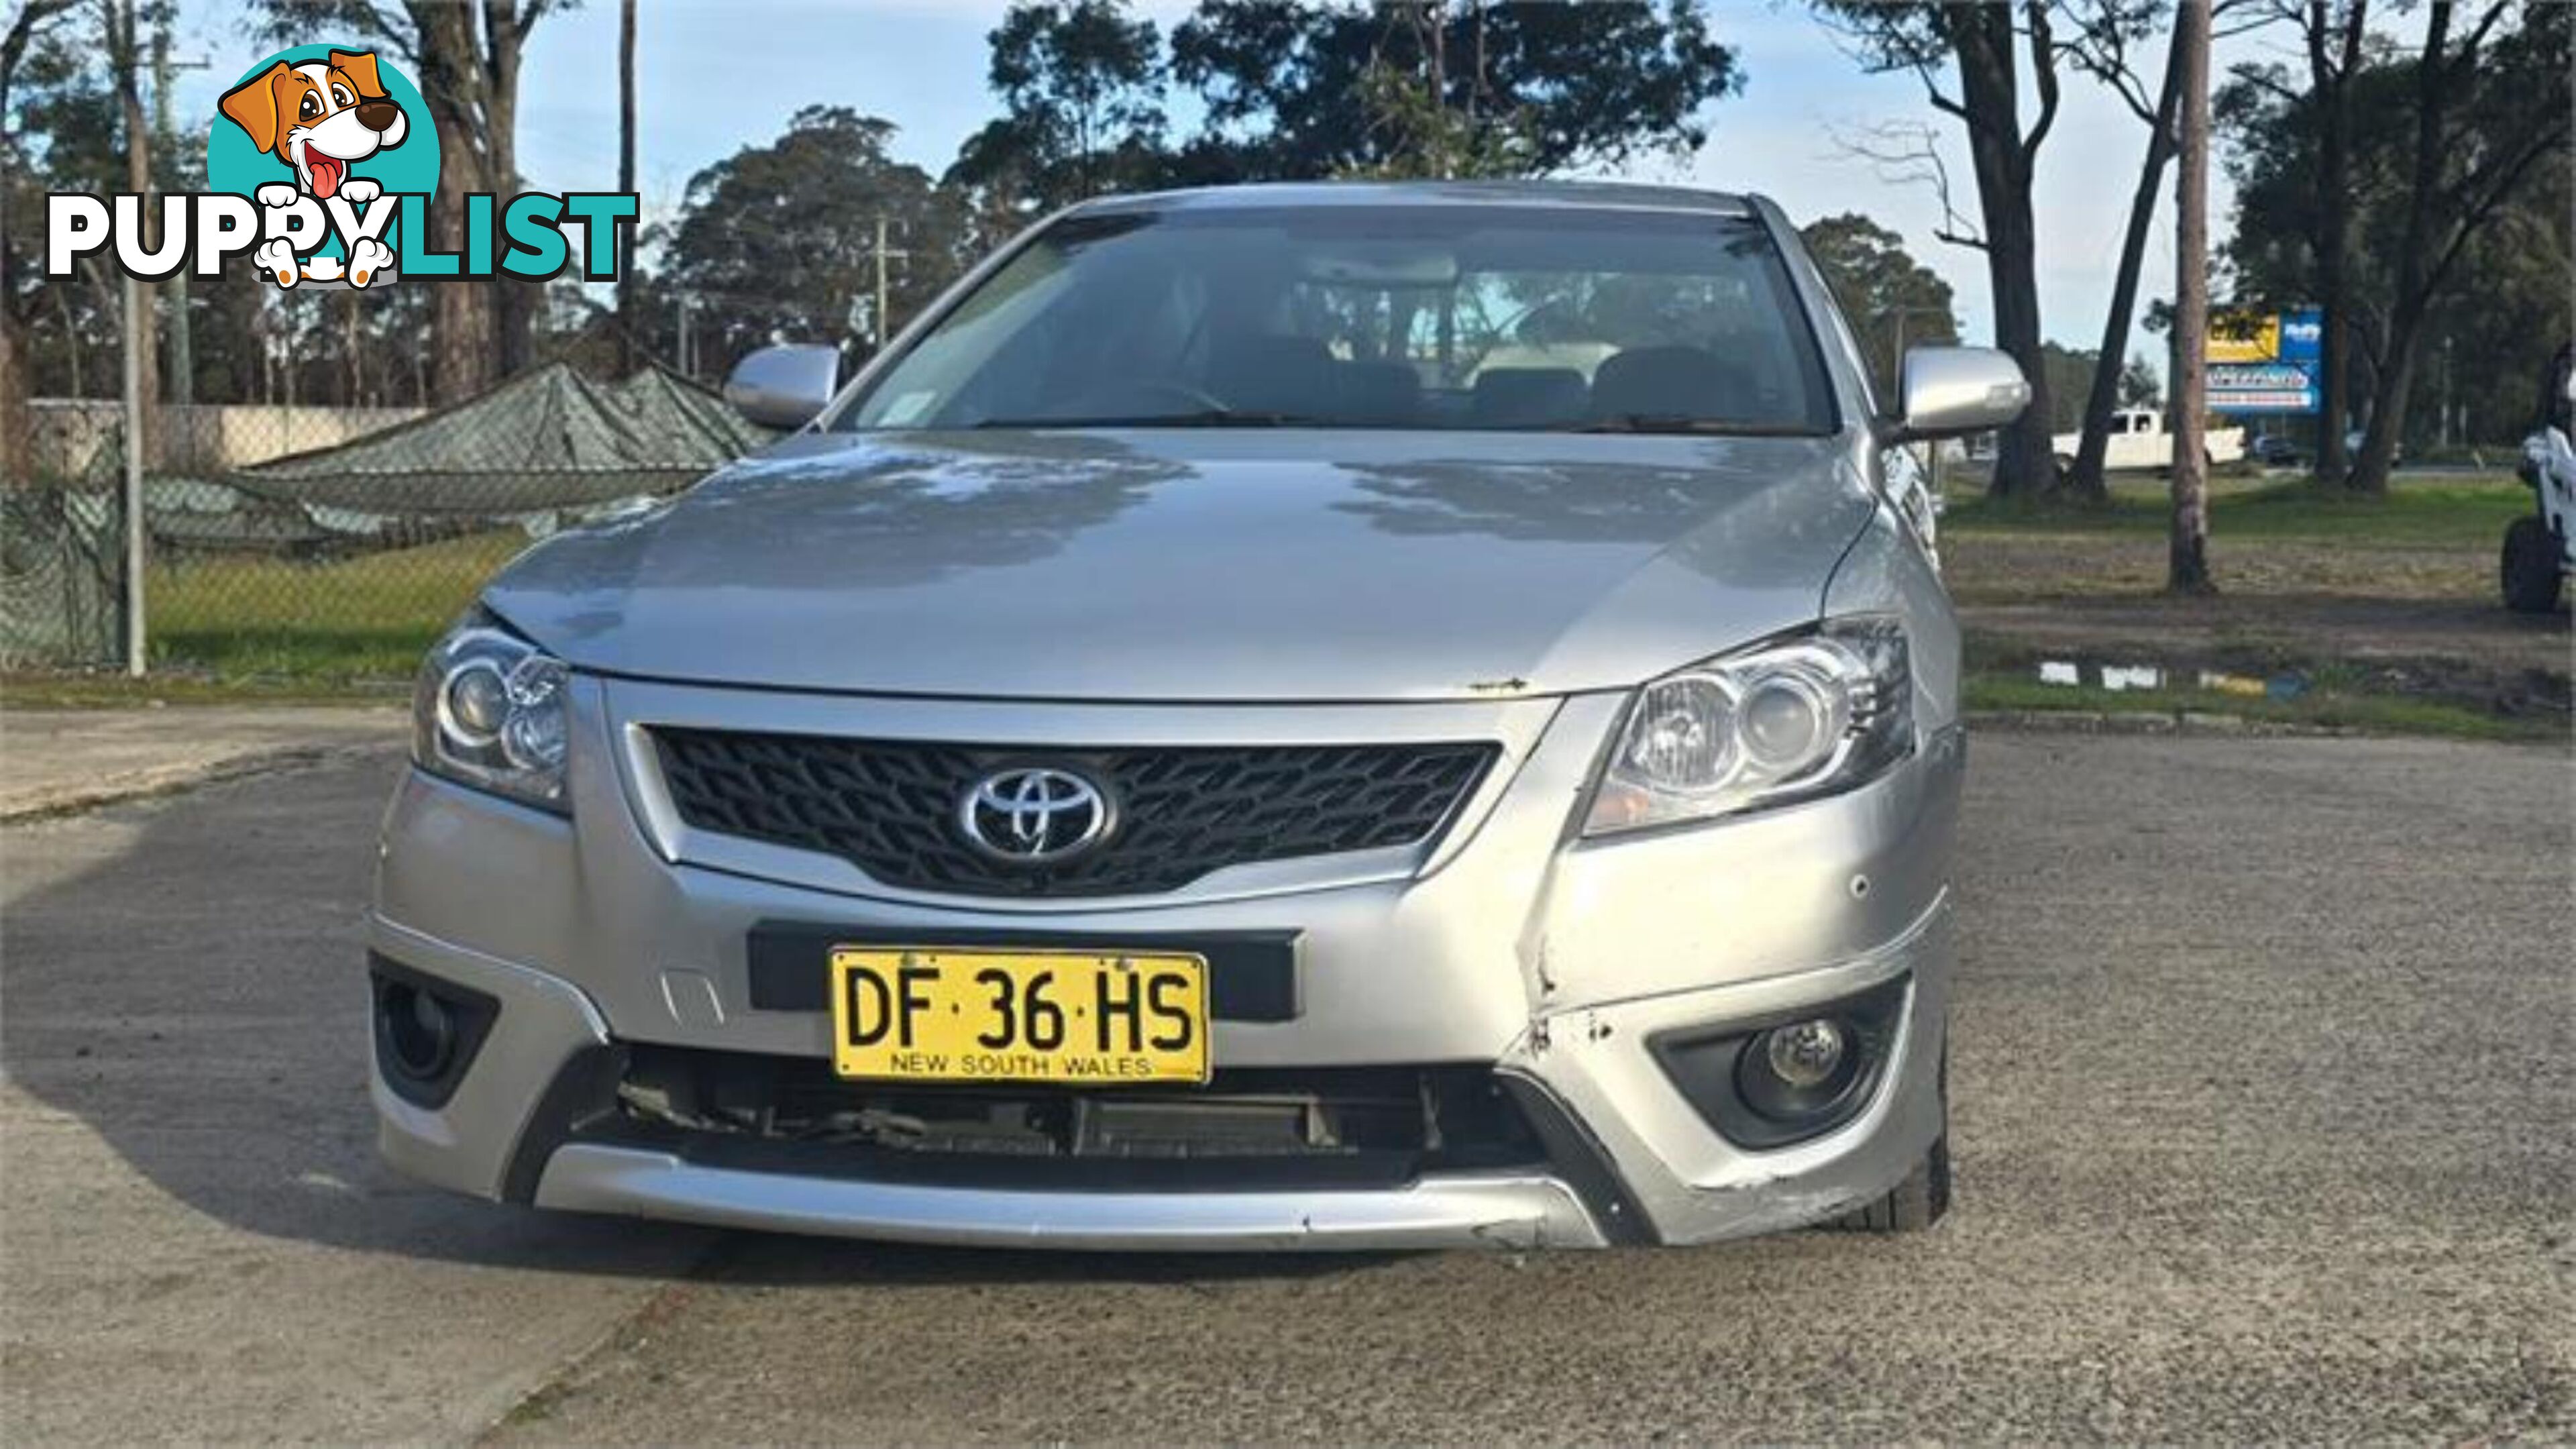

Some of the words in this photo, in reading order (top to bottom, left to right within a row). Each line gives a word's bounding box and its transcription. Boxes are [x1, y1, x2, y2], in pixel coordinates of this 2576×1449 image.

[891, 1055, 949, 1074] NEW
[961, 1055, 1049, 1074] SOUTH
[1064, 1057, 1152, 1075] WALES
